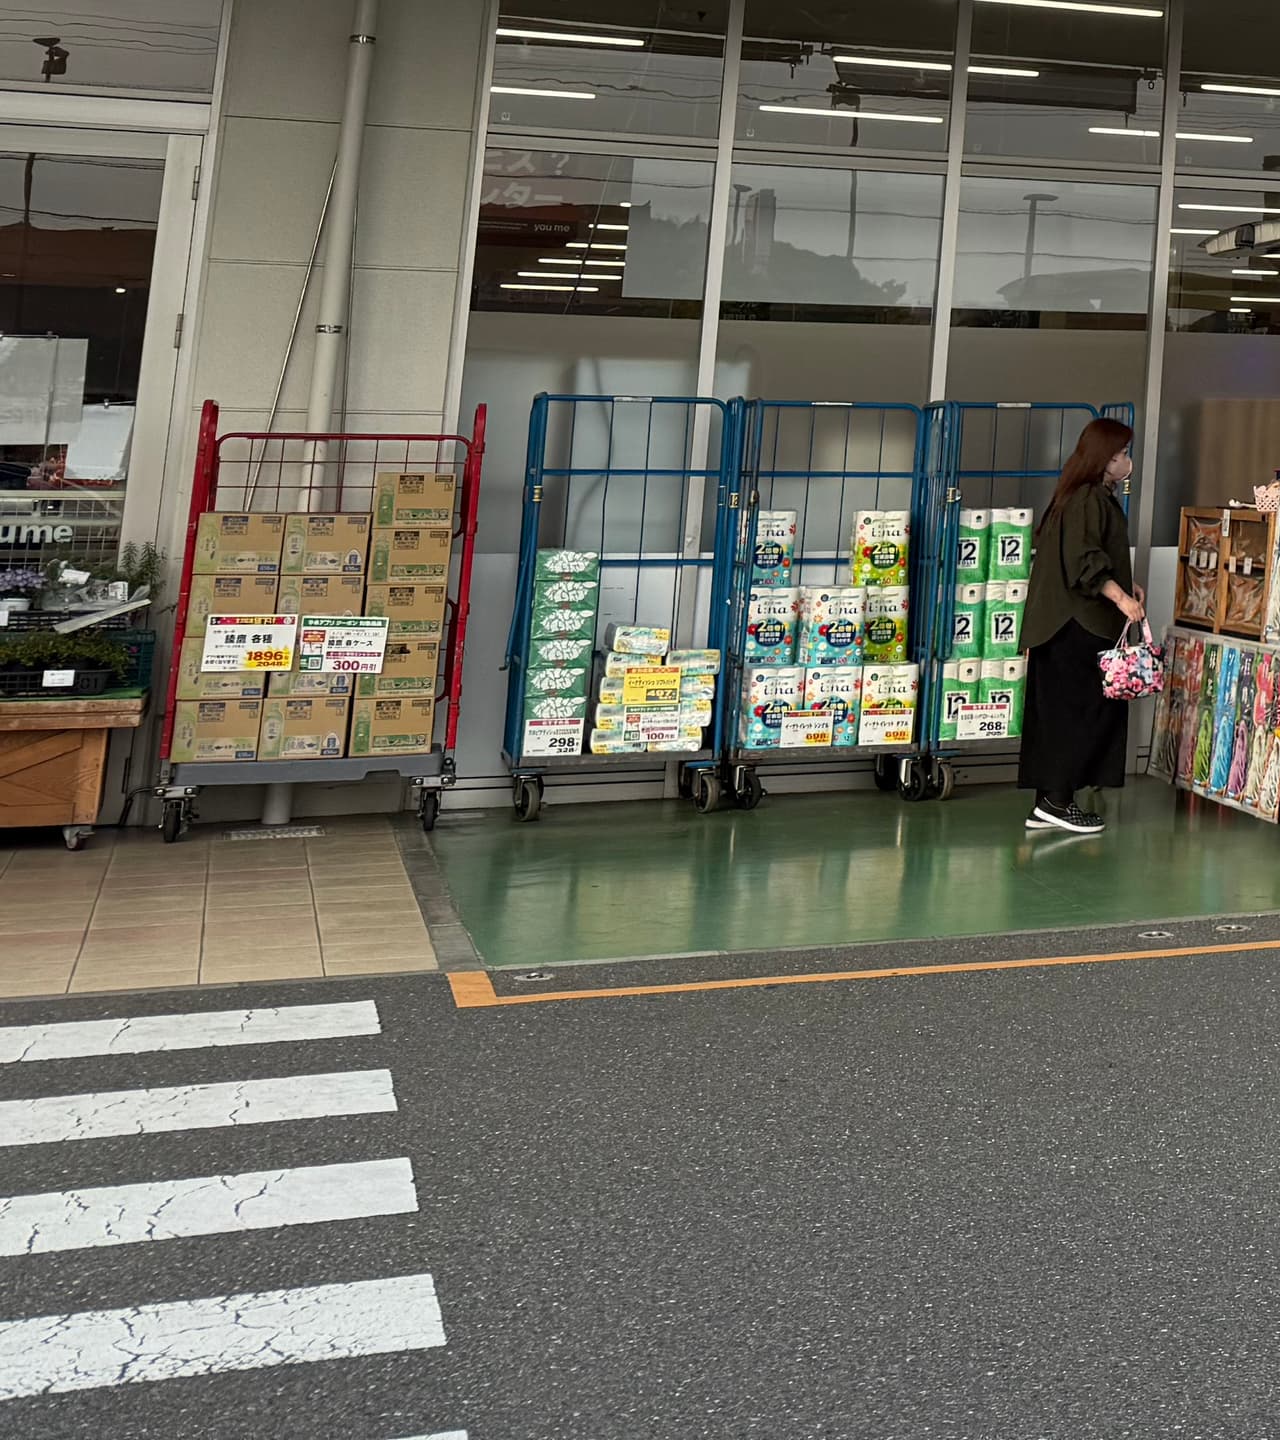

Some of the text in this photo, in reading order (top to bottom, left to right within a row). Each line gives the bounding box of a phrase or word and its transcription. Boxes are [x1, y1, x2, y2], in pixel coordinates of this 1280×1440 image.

[1001, 539, 1020, 557] 12
[994, 616, 1013, 635] 12
[979, 721, 1002, 731] 268
